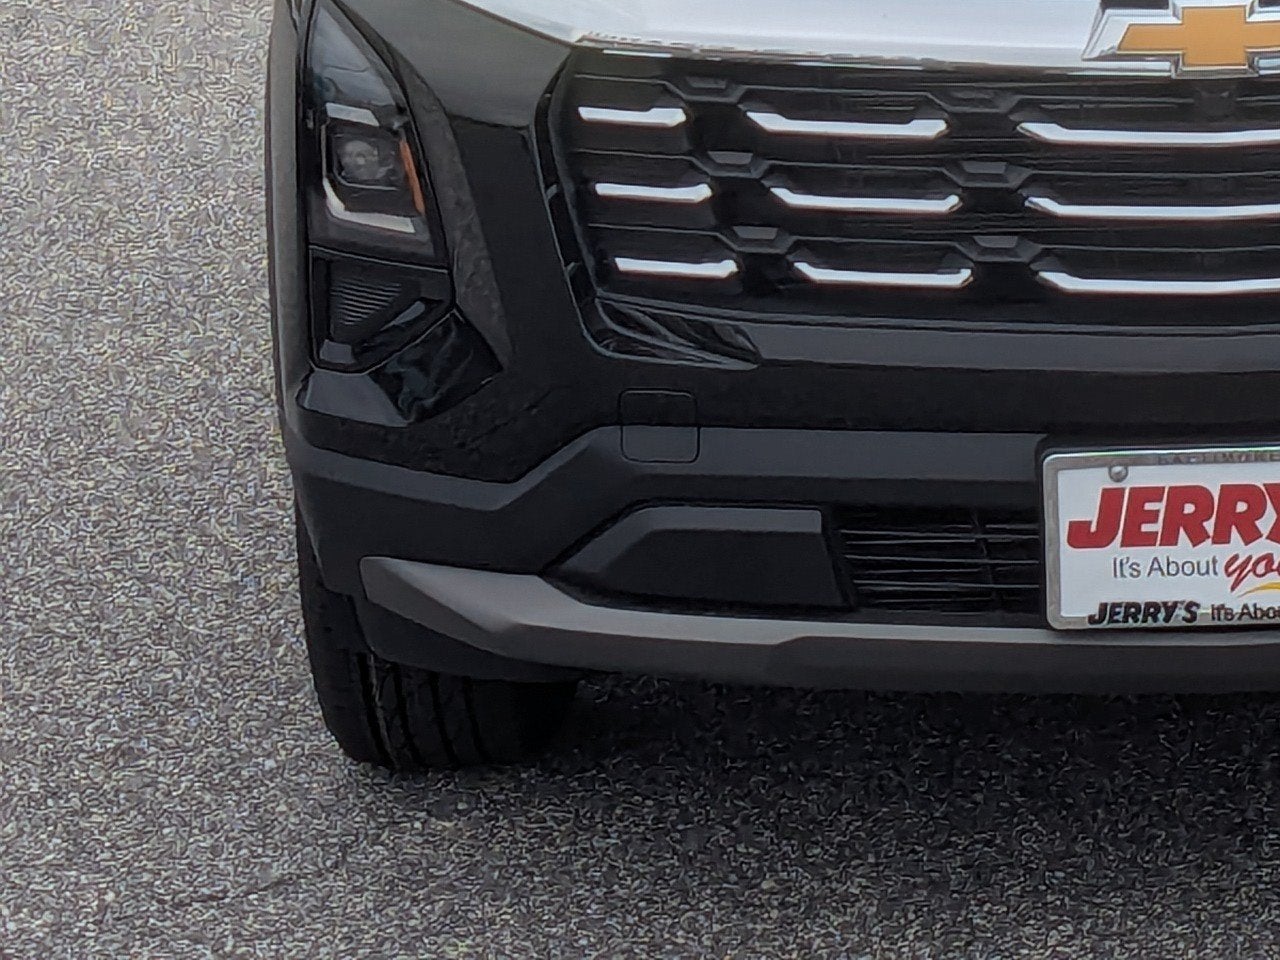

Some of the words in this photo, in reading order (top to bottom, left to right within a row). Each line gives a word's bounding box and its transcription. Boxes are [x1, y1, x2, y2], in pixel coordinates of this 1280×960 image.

[1113, 556, 1141, 578] It's
[1149, 555, 1219, 577] About
[1088, 600, 1201, 625] JERRY'S
[1210, 603, 1236, 621] It's
